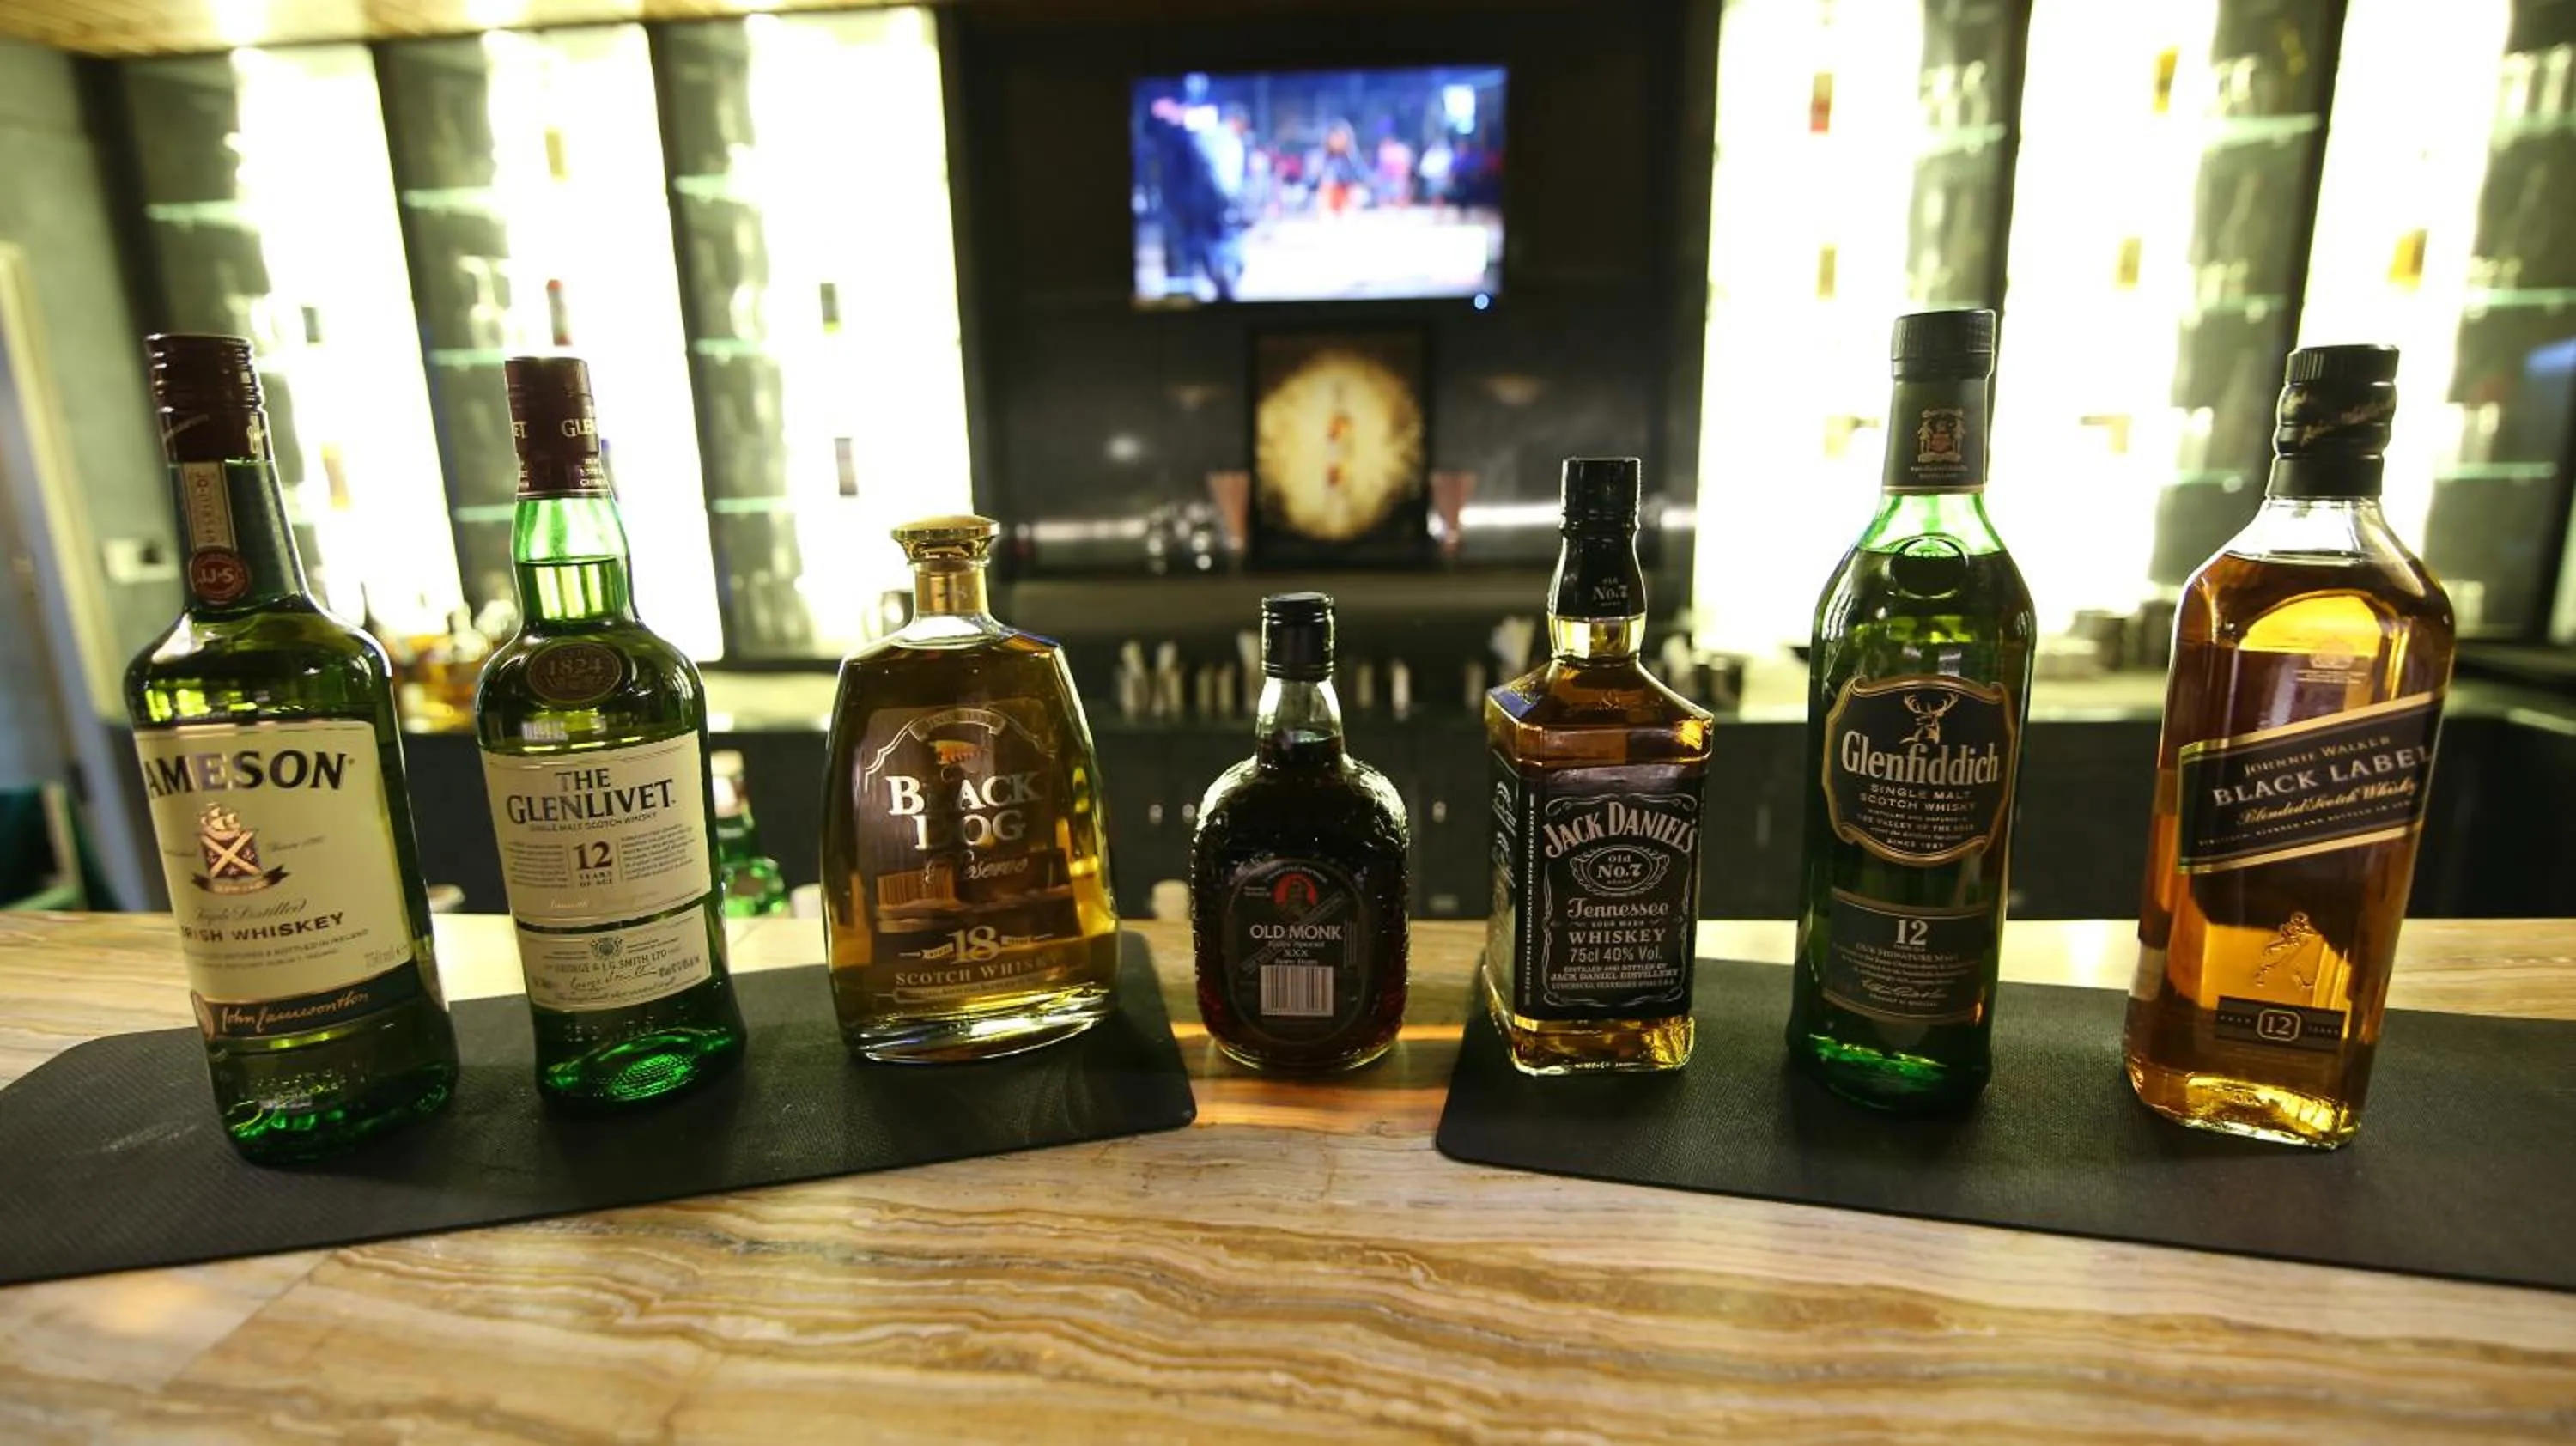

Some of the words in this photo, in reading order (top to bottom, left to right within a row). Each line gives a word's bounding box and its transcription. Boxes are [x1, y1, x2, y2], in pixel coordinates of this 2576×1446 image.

[1841, 731, 1999, 786] Glenfiddich
[2244, 751, 2315, 777] JOHNNIE
[2321, 735, 2391, 758] WALKER
[144, 750, 346, 797] AMESON
[555, 768, 611, 792] THE
[2212, 770, 2318, 807] BLACK
[2330, 744, 2433, 782] LABEL
[506, 779, 674, 824] GLENLIVET
[885, 773, 1042, 816] BACK
[1859, 792, 1918, 811] SCOTCH
[1924, 802, 1977, 811] WHISKY
[1870, 782, 1929, 799] SINGLE
[1932, 791, 1971, 800] MALT
[1542, 811, 1604, 859] JACK
[1608, 801, 1697, 854] DANIEL'S
[573, 841, 612, 871] 12
[1607, 854, 1631, 863] Old
[1596, 863, 1642, 879] No.7
[1567, 897, 1668, 920] Tennessee
[232, 912, 344, 941] WHISKEY
[1250, 924, 1285, 939] OLD
[1289, 924, 1343, 940] MONK
[1568, 927, 1667, 945] WHISKEY
[1896, 919, 1929, 945] 12
[946, 925, 1003, 964] 18
[1569, 946, 1598, 963] 75cl
[1603, 946, 1634, 961] 40%
[1638, 945, 1663, 960] Vol.
[896, 969, 971, 987] SCOTCH
[2266, 1015, 2293, 1036] 12
